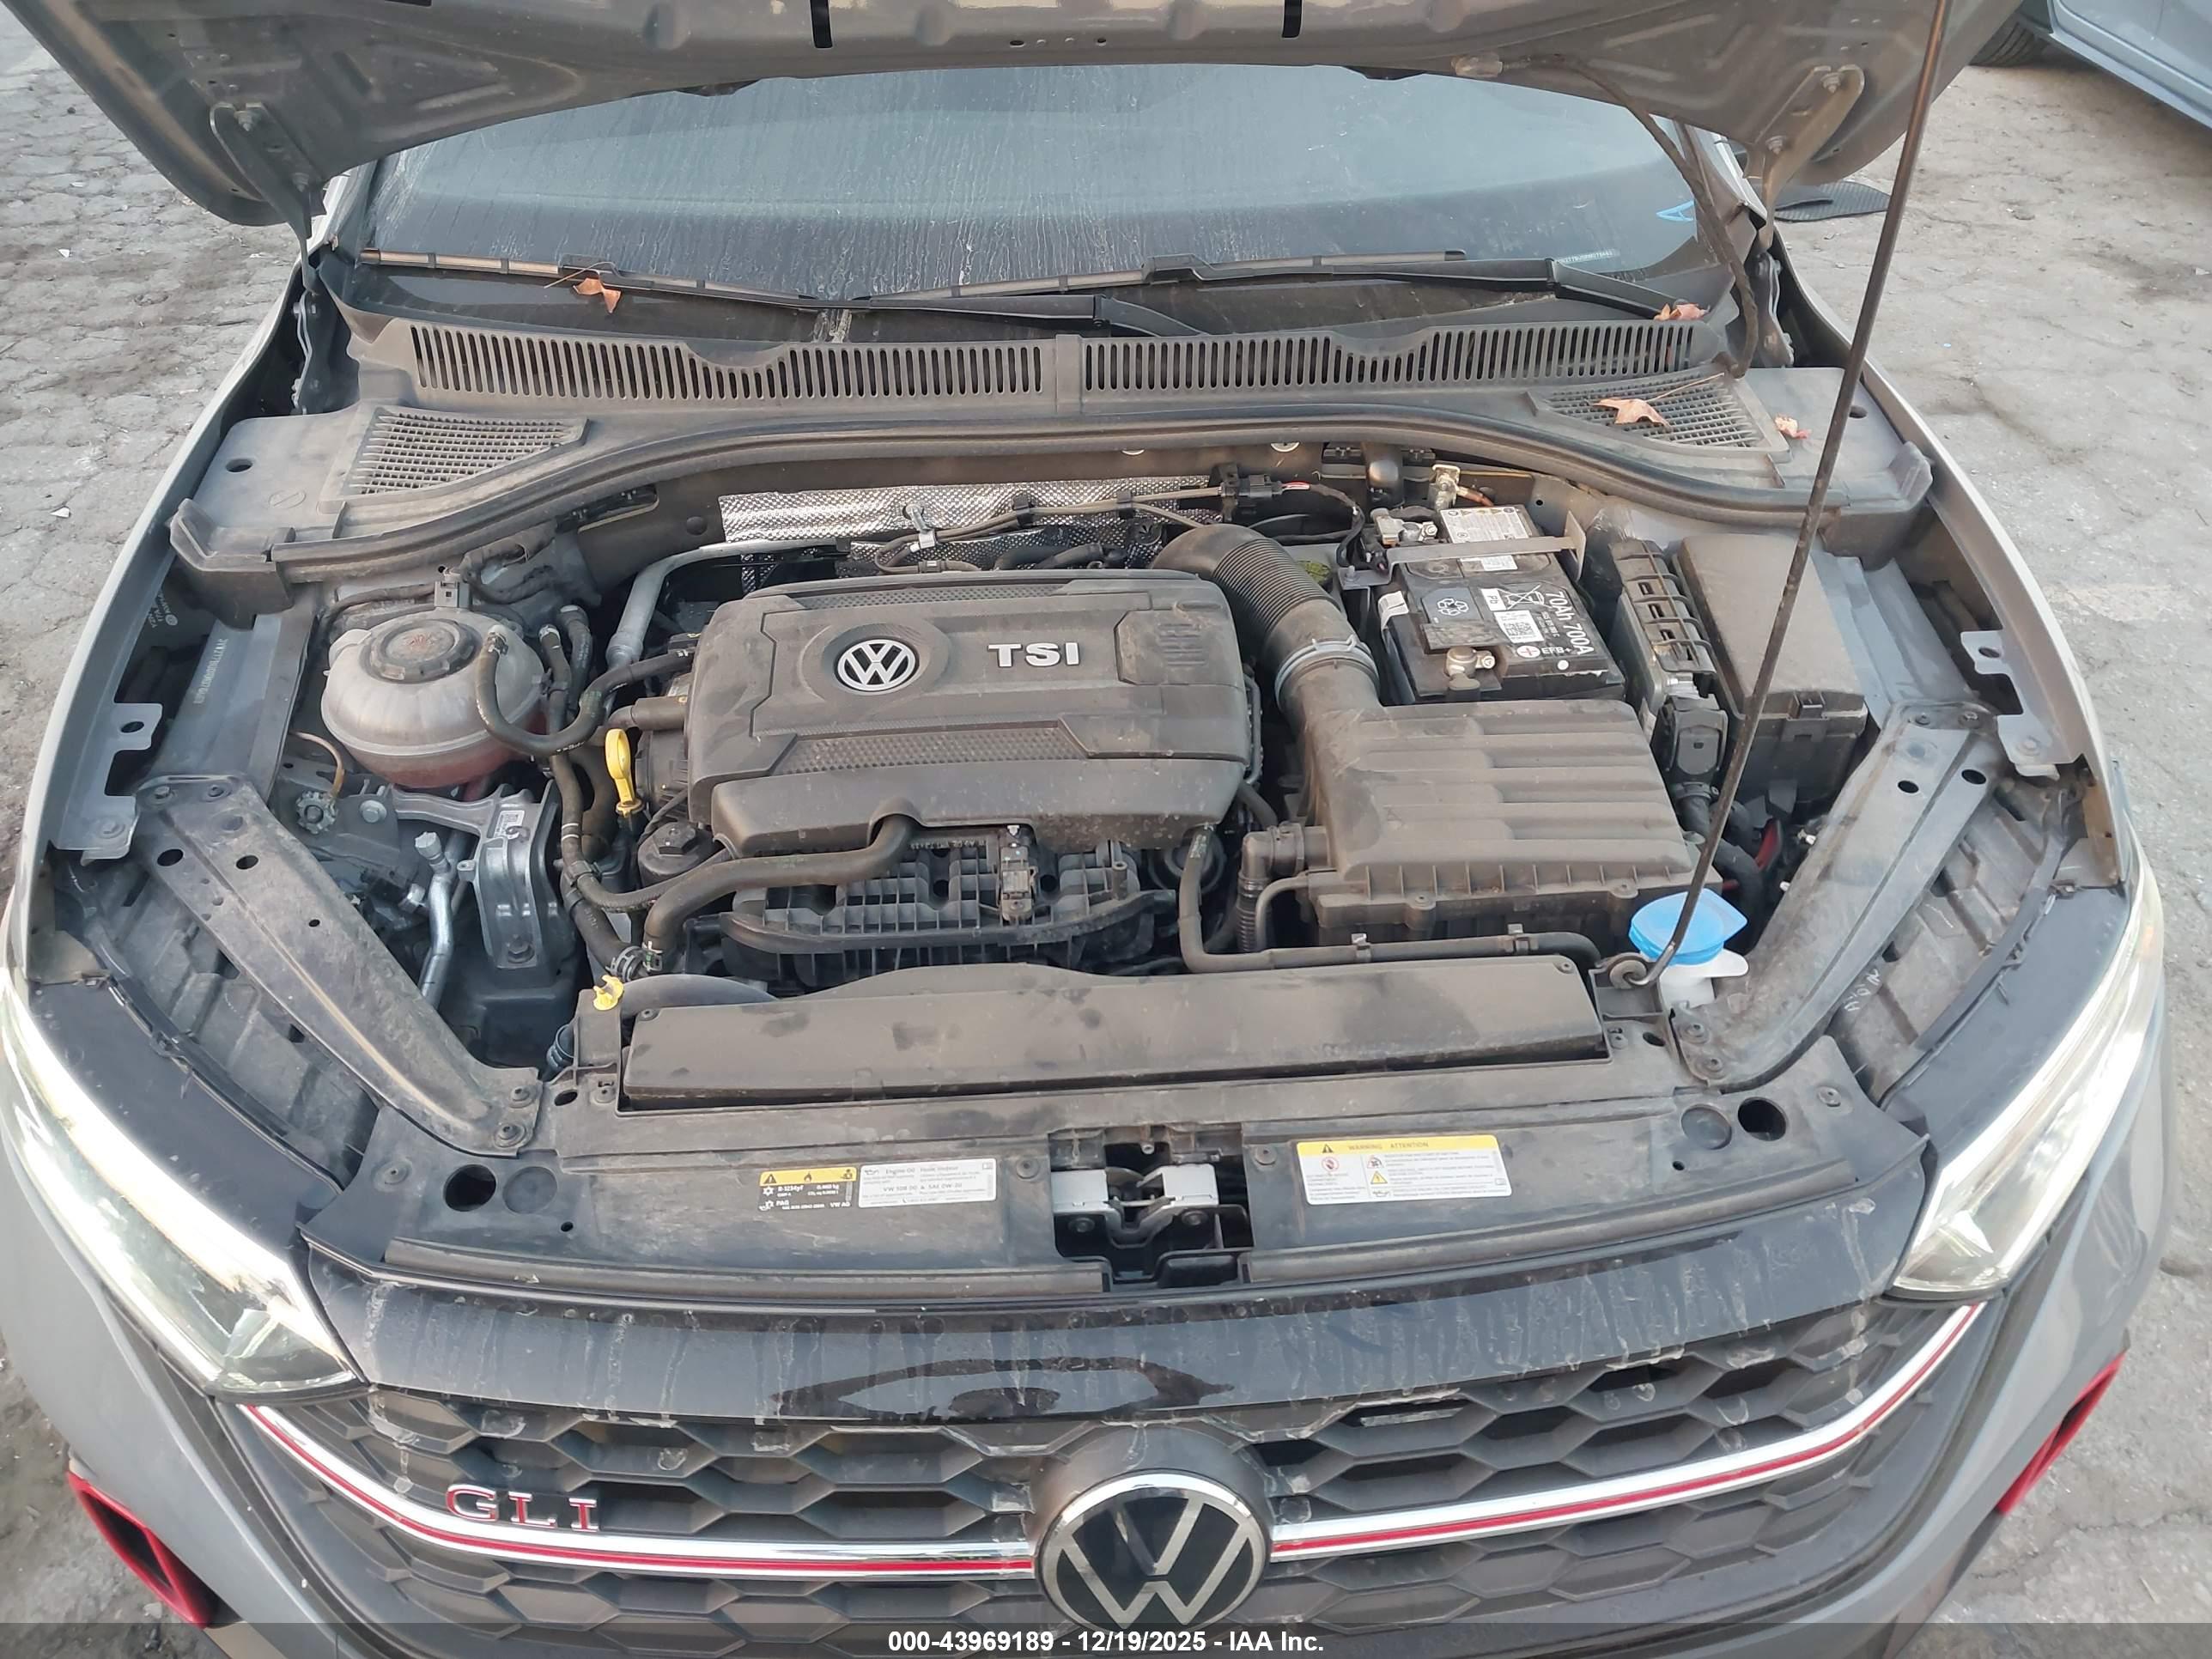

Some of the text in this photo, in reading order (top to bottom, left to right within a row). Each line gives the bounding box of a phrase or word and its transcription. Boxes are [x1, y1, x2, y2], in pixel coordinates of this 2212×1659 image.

[1546, 591, 1576, 621] 70Ah
[1563, 623, 1595, 655] 700A
[988, 641, 1080, 668] TSI
[1540, 646, 1572, 655] EFB+
[446, 1484, 600, 1533] GLI
